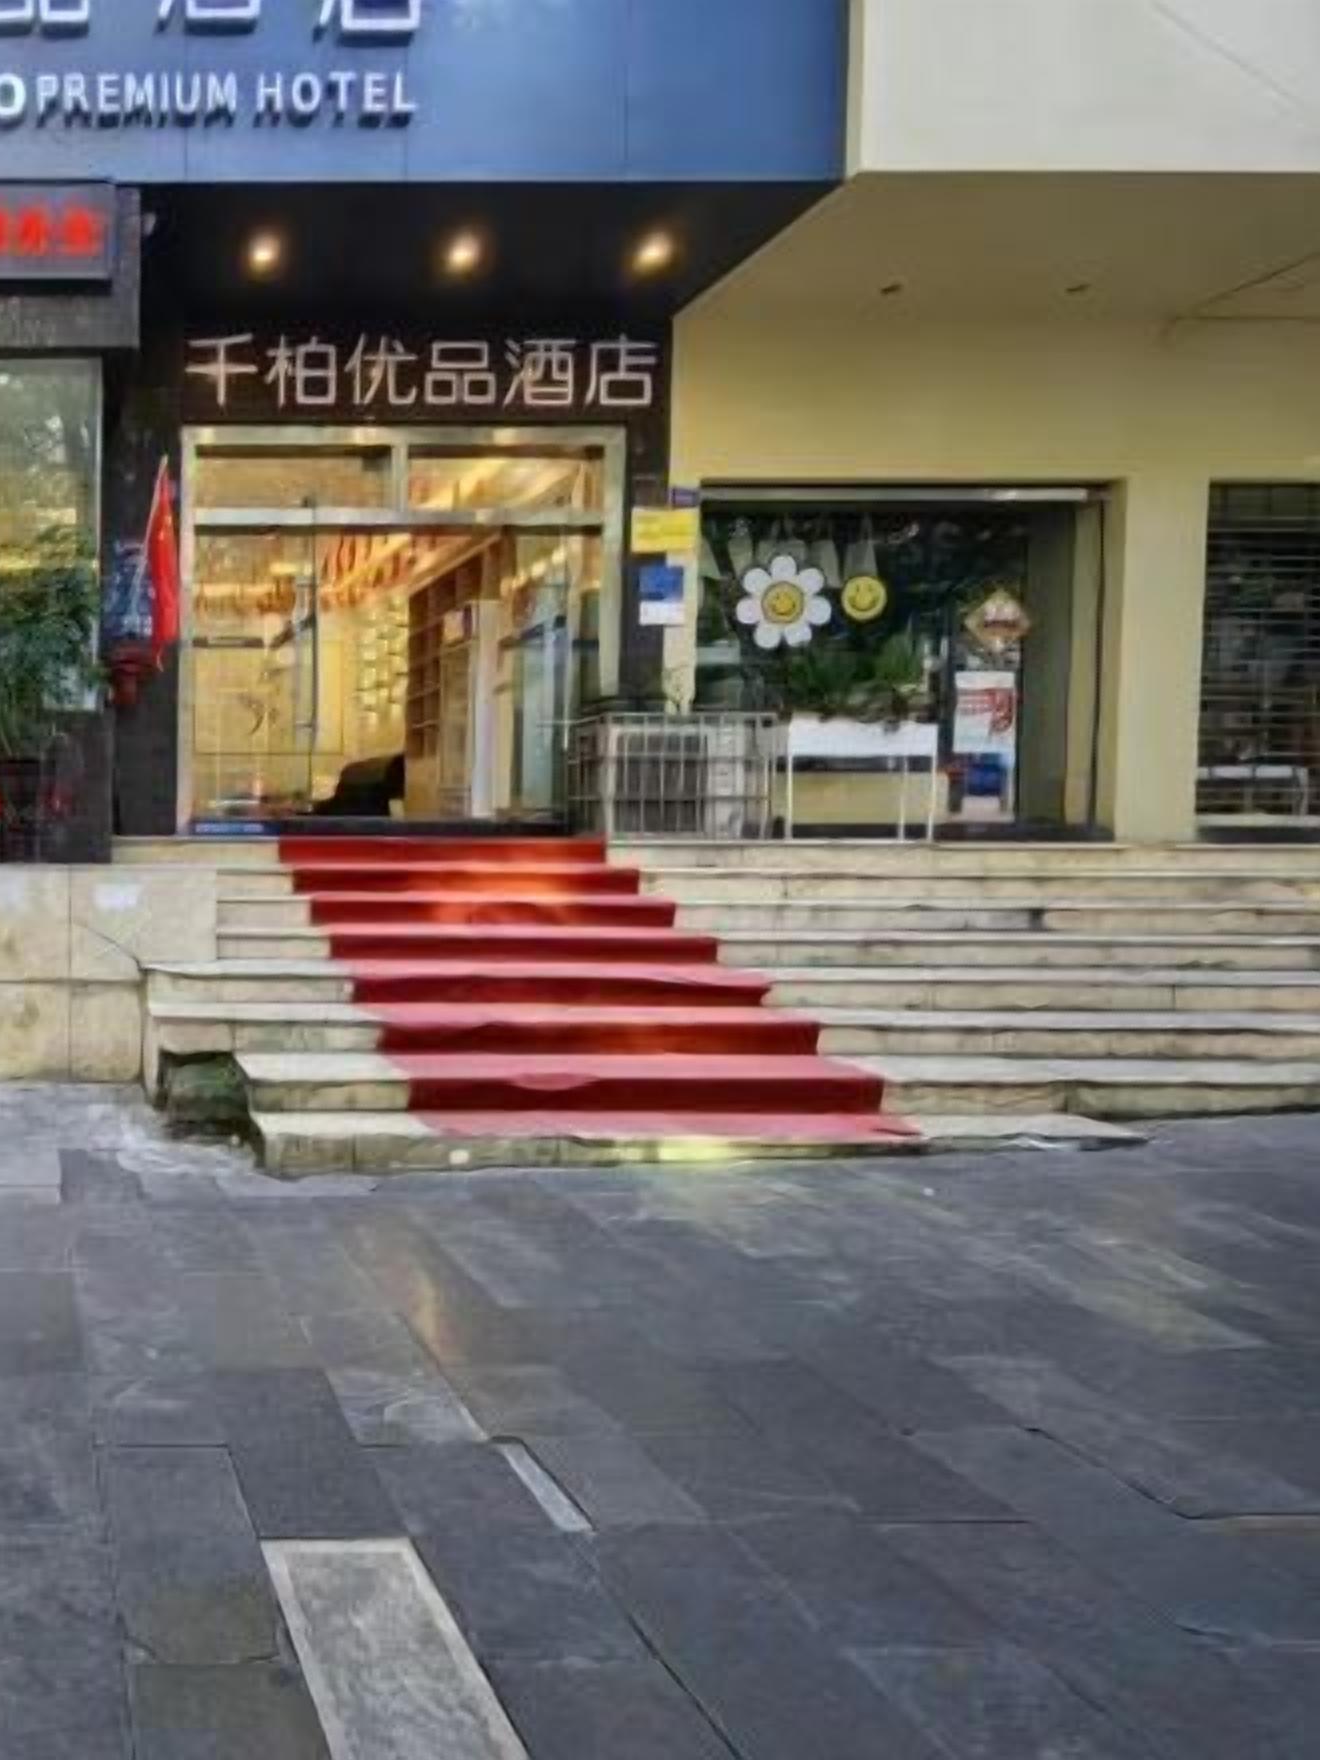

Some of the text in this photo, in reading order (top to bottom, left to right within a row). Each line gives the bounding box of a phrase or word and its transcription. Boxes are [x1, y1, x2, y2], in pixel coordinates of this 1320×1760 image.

[35, 74, 238, 115] PREMIUM
[258, 74, 418, 114] HOTEL
[185, 333, 658, 408] 千柏优品酒店
